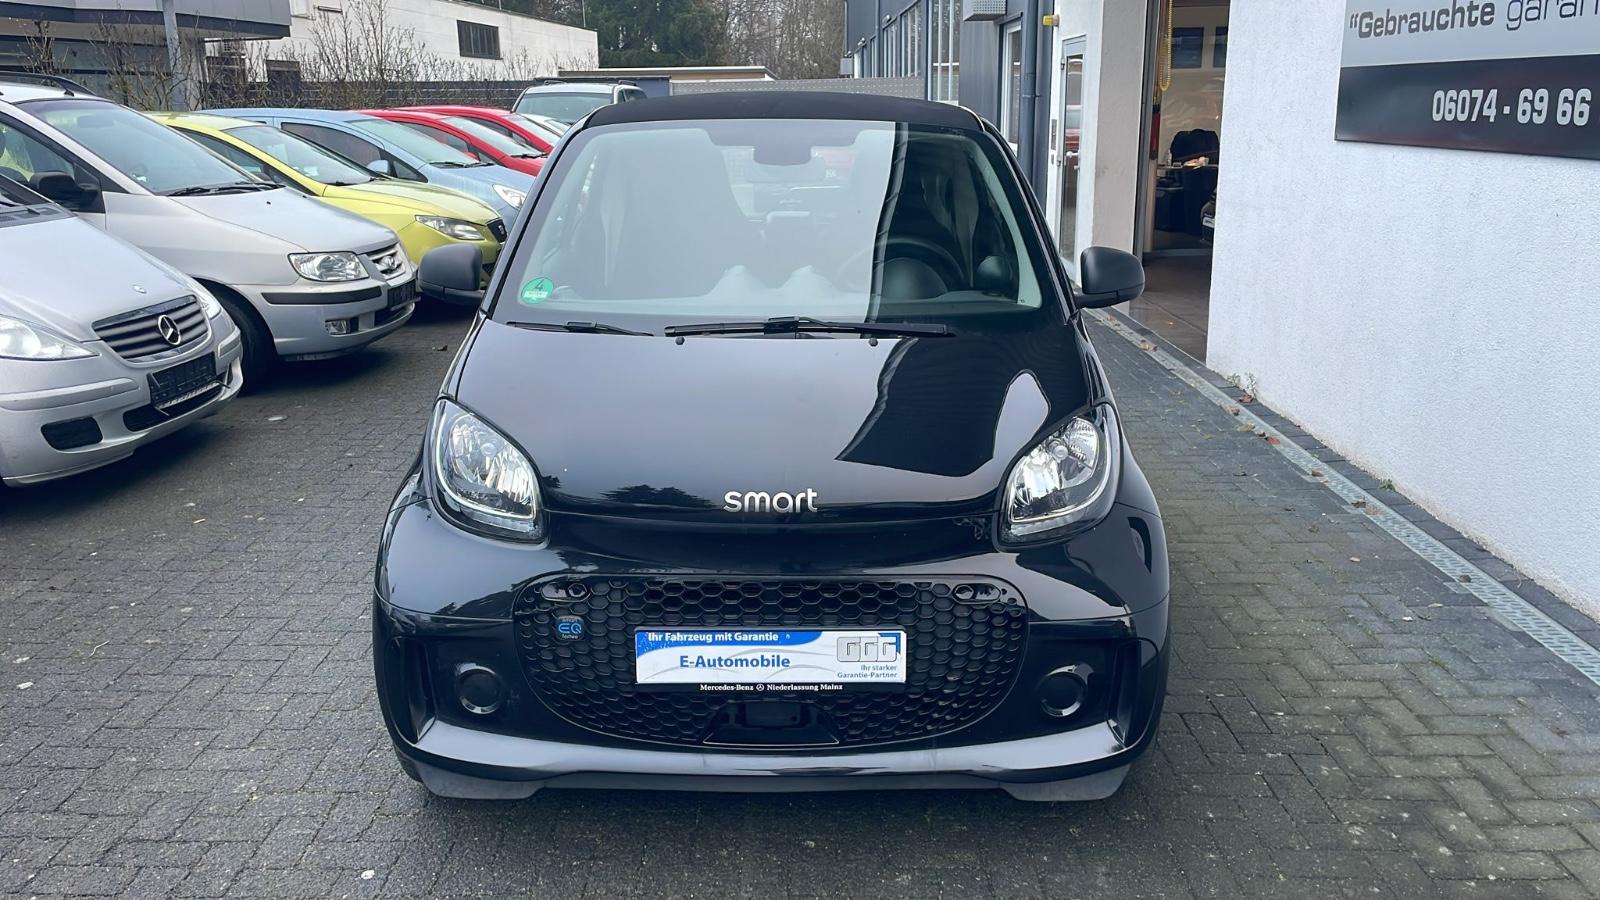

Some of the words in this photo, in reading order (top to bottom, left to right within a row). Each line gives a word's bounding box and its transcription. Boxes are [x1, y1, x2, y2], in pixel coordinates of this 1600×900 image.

[1432, 88, 1498, 122] 06074
[1517, 88, 1549, 125] 69
[1556, 88, 1592, 126] 66
[534, 279, 544, 291] 4
[723, 488, 818, 513] smart
[558, 622, 582, 634] EQ
[648, 632, 664, 642] Ihr
[665, 632, 713, 643] Fahrzeug
[715, 632, 732, 642] mit
[734, 632, 779, 642] Garantie
[679, 655, 791, 668] E-Automobile
[837, 671, 898, 679] Garantie-Partner
[766, 684, 819, 692] Niederlassung
[820, 683, 843, 691] Mainz
